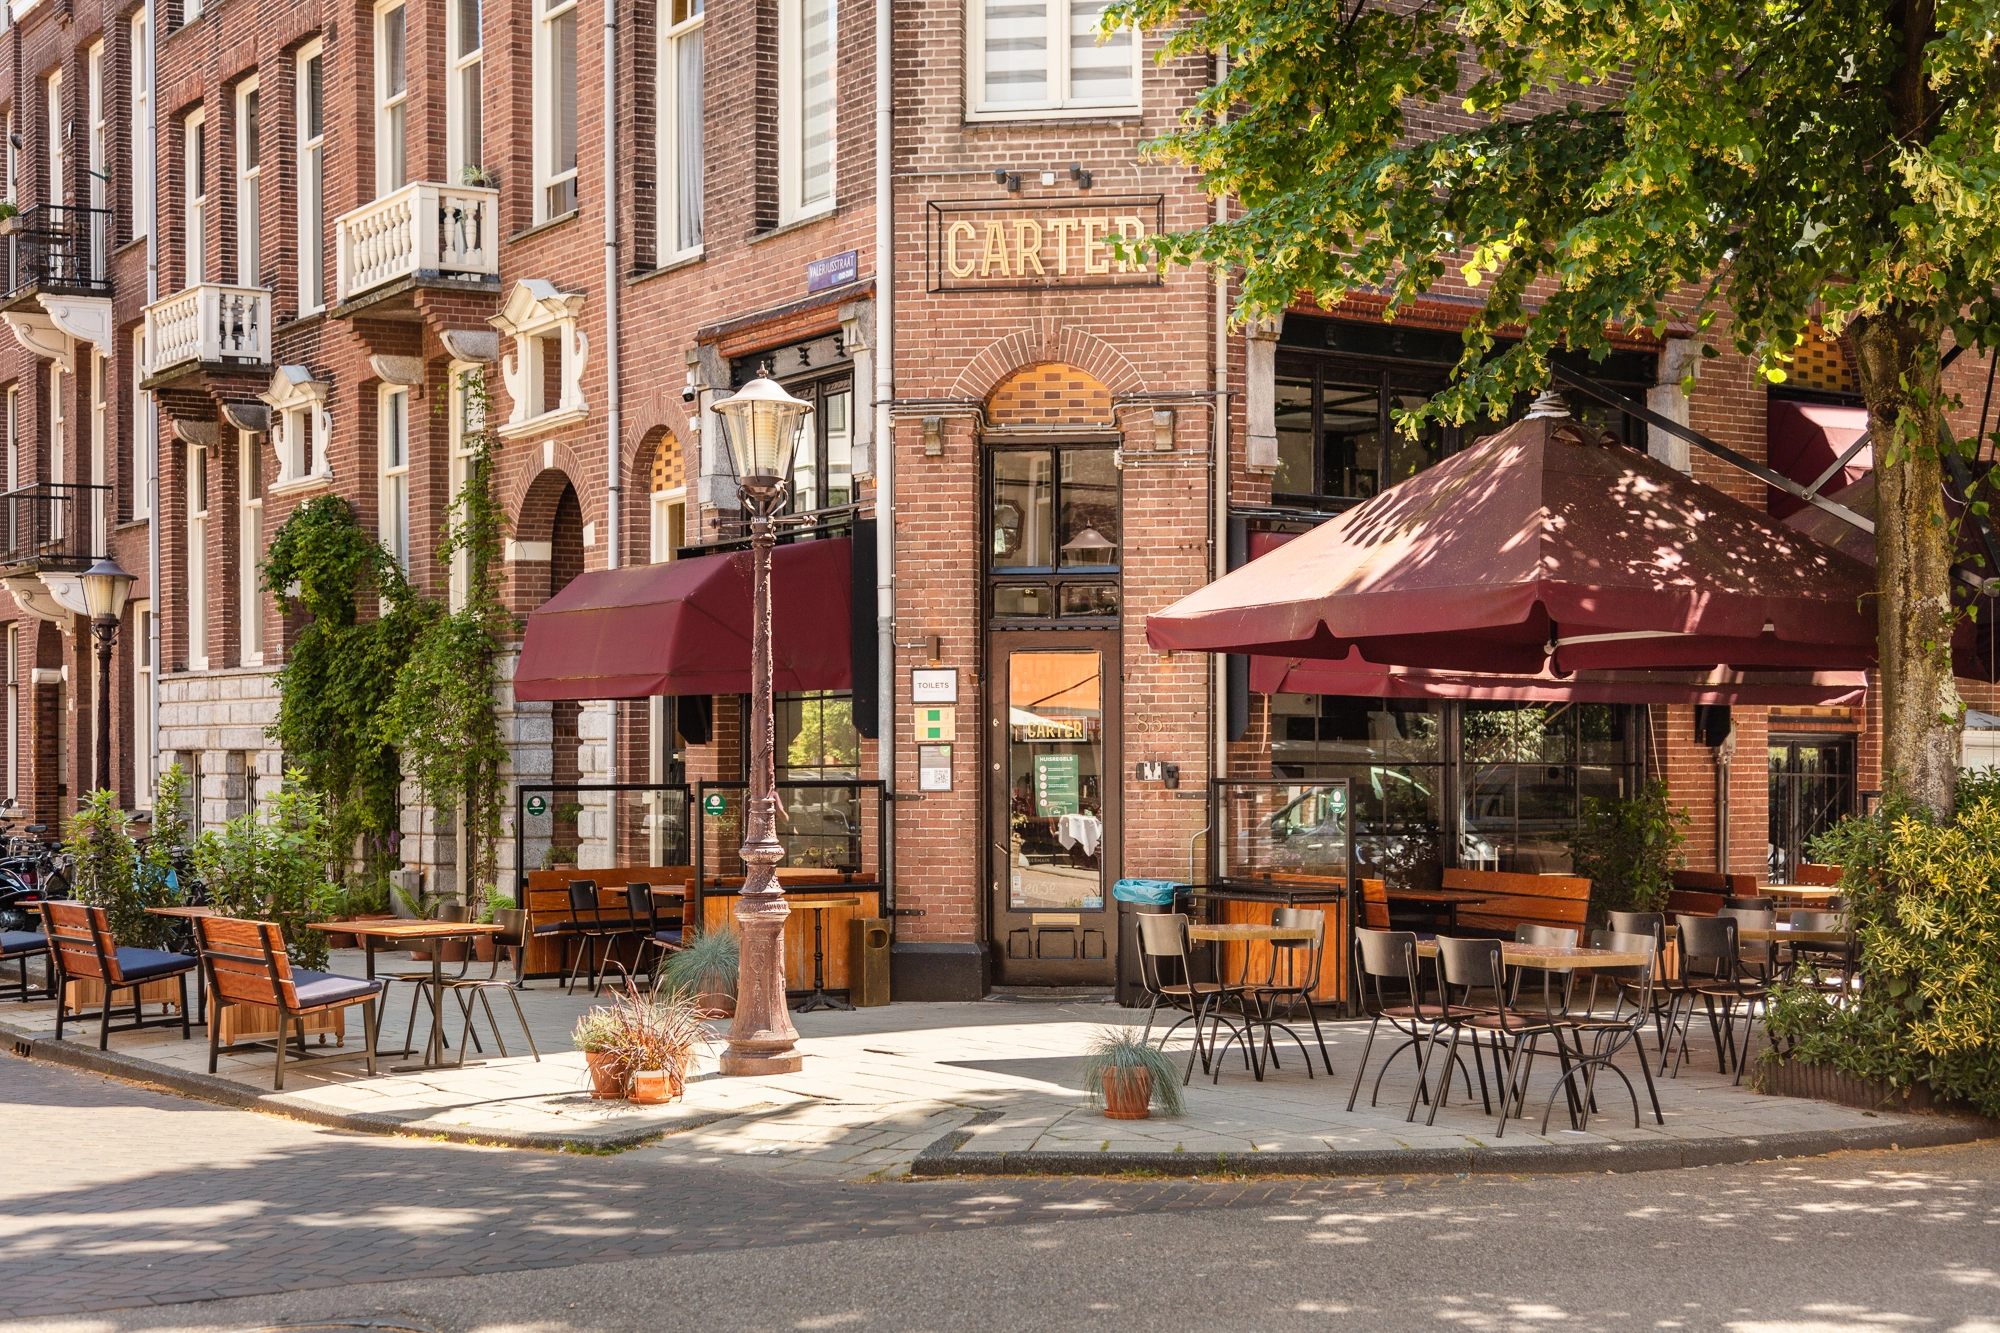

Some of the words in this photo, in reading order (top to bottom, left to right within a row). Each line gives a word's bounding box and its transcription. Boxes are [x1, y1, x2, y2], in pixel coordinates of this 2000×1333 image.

[947, 215, 1148, 278] CARTER
[809, 255, 854, 278] VALERIUSSTRAAT
[1027, 720, 1083, 738] CARTER
[1137, 713, 1163, 732] 85
